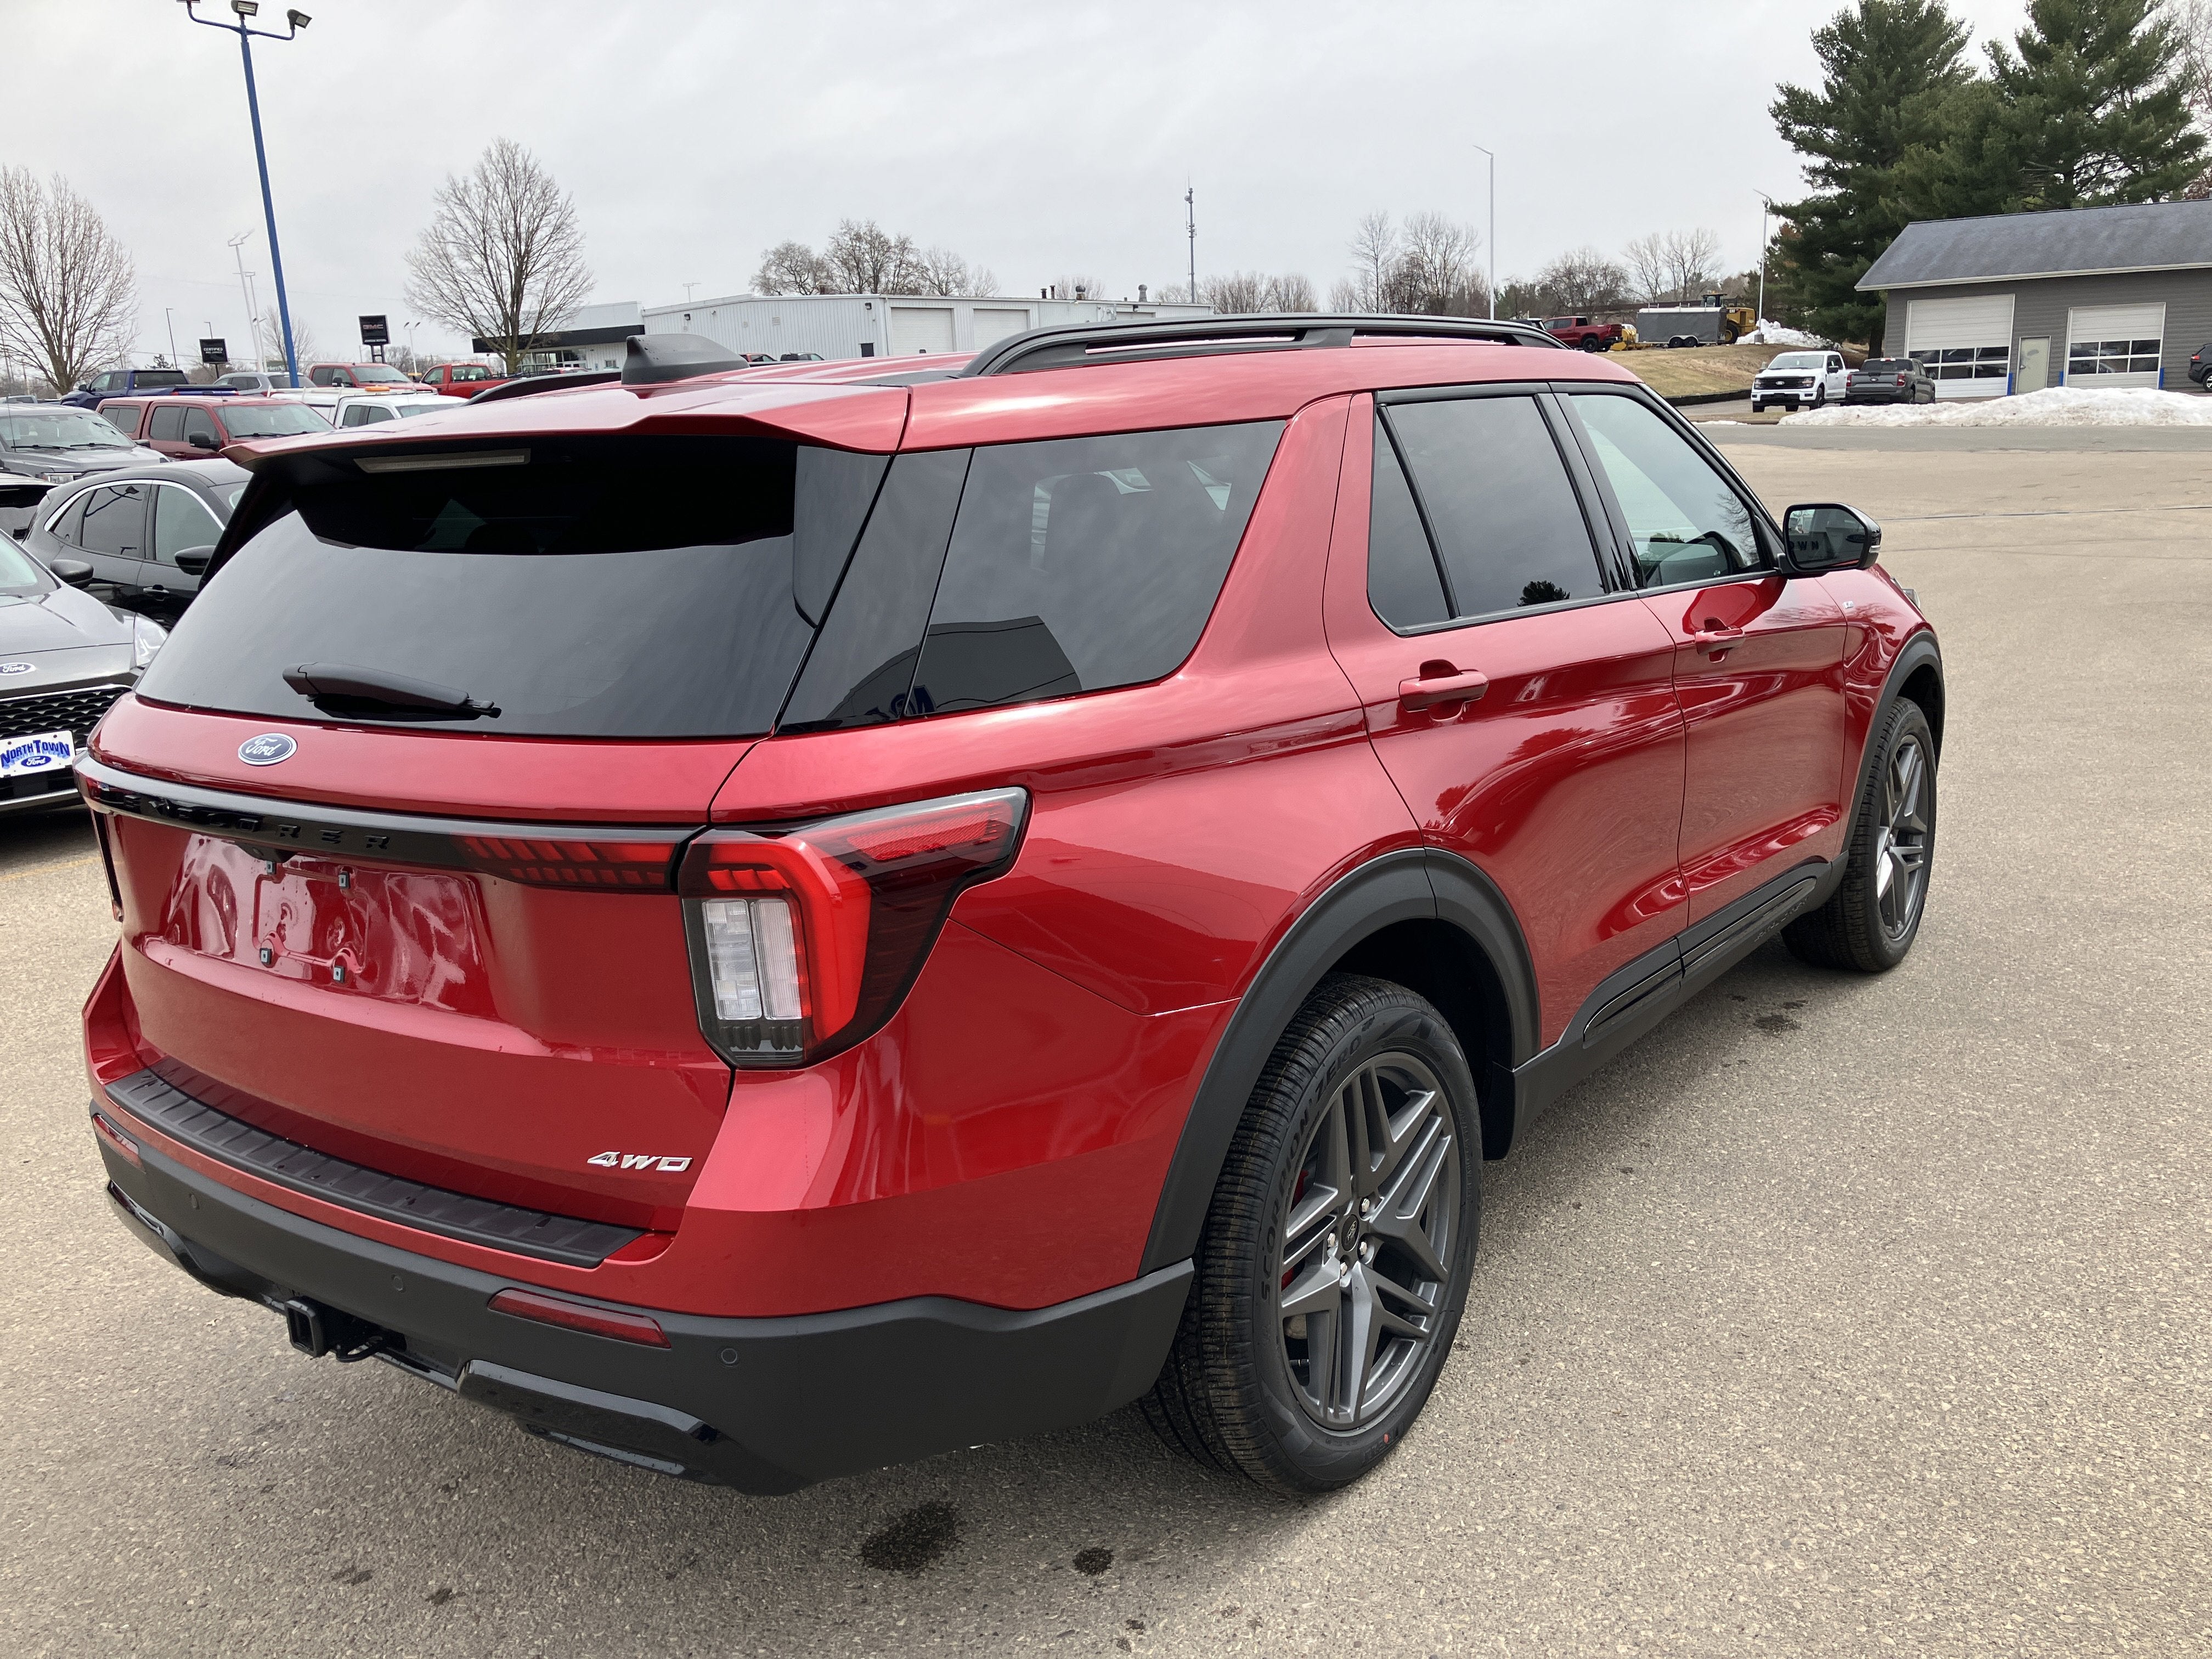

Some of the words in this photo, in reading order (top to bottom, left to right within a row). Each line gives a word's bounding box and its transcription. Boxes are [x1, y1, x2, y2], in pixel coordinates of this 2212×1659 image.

[2, 664, 26, 673] Ford
[245, 737, 282, 756] Ford
[26, 756, 46, 765] Ford
[586, 1150, 693, 1172] 4WD
[1261, 1113, 1309, 1302] SCORPION
[1314, 1035, 1362, 1103] ZERO
